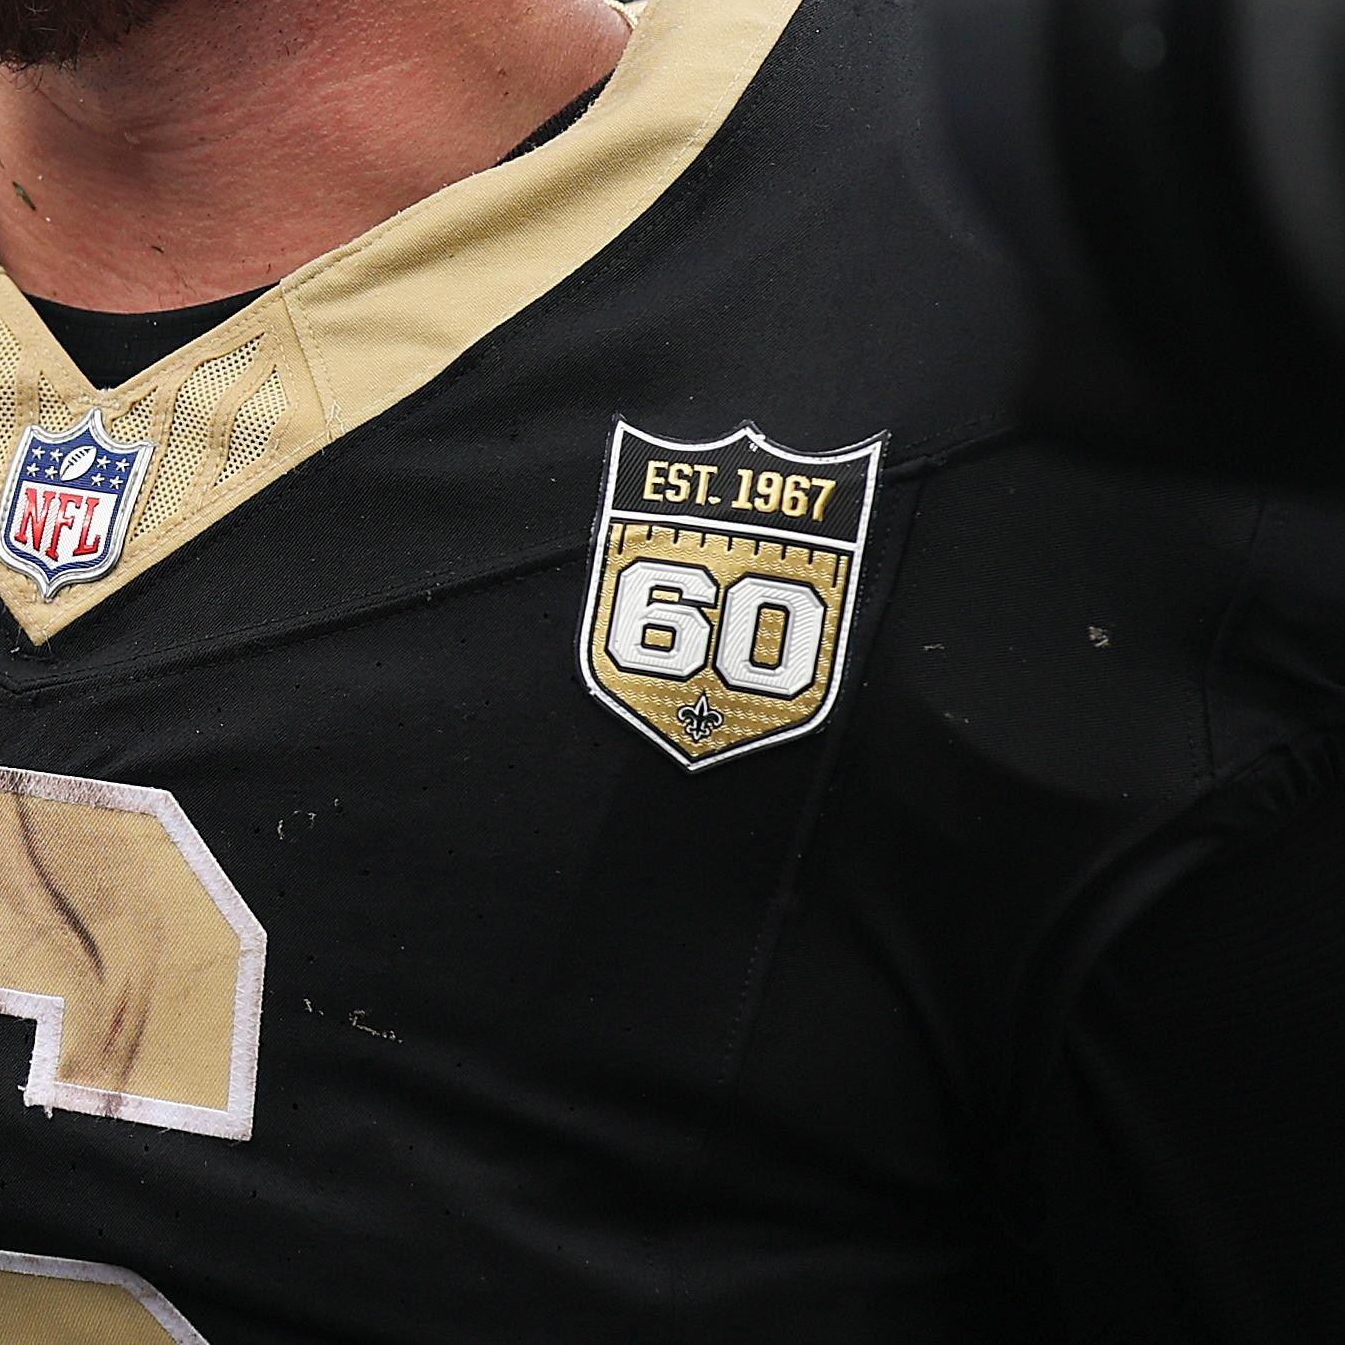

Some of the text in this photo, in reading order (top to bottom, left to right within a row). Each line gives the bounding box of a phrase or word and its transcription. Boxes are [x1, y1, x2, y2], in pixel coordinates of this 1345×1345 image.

[14, 487, 101, 562] NFL
[642, 460, 837, 522] EST. 1967
[605, 558, 827, 700] 60
